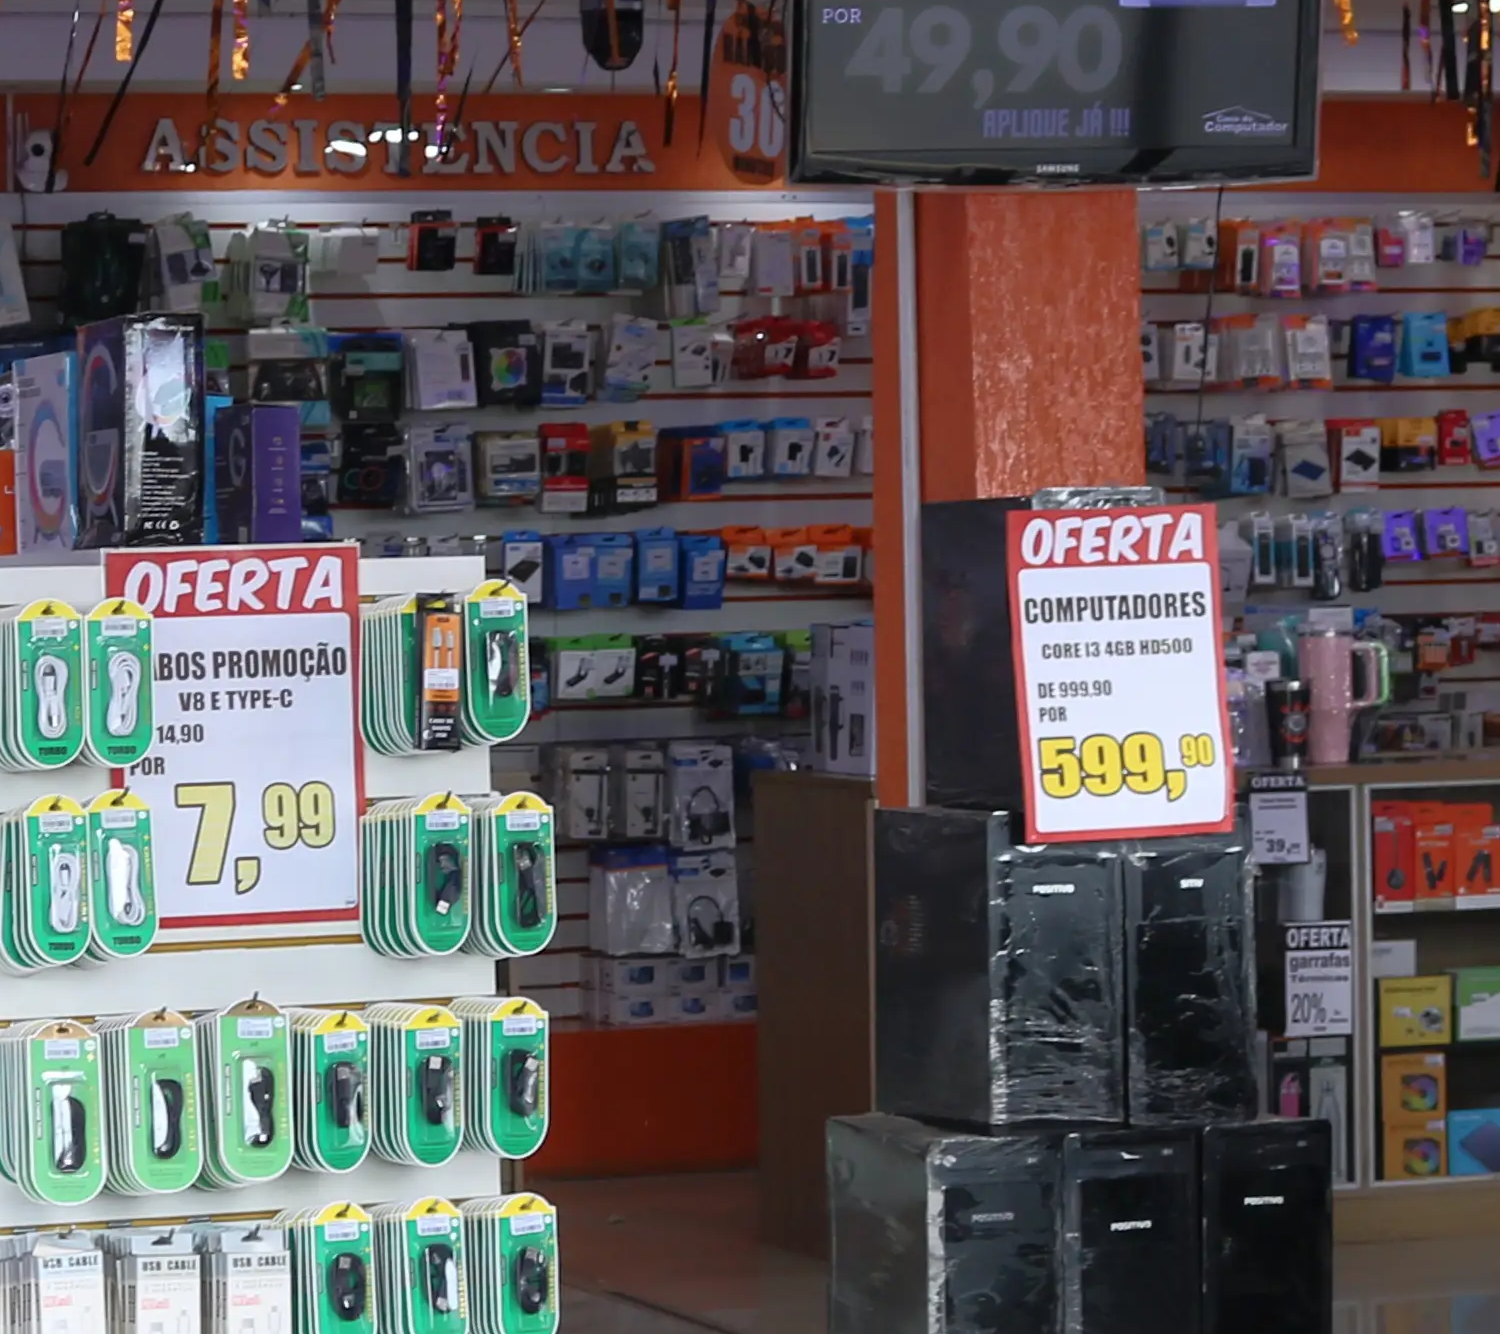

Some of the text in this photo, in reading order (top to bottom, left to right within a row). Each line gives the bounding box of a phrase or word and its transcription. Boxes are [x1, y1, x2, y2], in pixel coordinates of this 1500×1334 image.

[822, 8, 862, 24] POR
[844, 4, 1122, 110] 49,90
[982, 108, 1069, 138] APLIQUE
[1075, 101, 1102, 137] JÁ
[1204, 120, 1289, 134] Computador
[143, 117, 656, 176] ASSISTENCIA
[1036, 163, 1080, 173] SAMSUNG
[1021, 512, 1203, 565] OFERTA
[124, 555, 344, 613] OFERTA
[1024, 592, 1207, 624] COMPUTADORES
[1041, 641, 1081, 659] CORE
[1105, 639, 1136, 657] 4GB
[1140, 637, 1193, 656] HD500
[154, 642, 348, 683] BOS PROMOÇÃO
[179, 689, 294, 712] V8 E TYPE-C
[1038, 682, 1056, 699] DE
[1038, 707, 1068, 723] POR
[156, 724, 205, 745] 14,90
[130, 757, 166, 777] POR
[1037, 731, 1216, 802] 599,90
[1251, 775, 1305, 789] OFERTA
[174, 779, 337, 896] 7,99
[1286, 927, 1351, 949] OFERTA
[1289, 952, 1351, 972] garrafas
[1291, 992, 1327, 1024] 20%
[69, 1255, 99, 1268] CABLE
[142, 1259, 197, 1272] USB CABLE
[233, 1255, 287, 1269] USB CABLE
